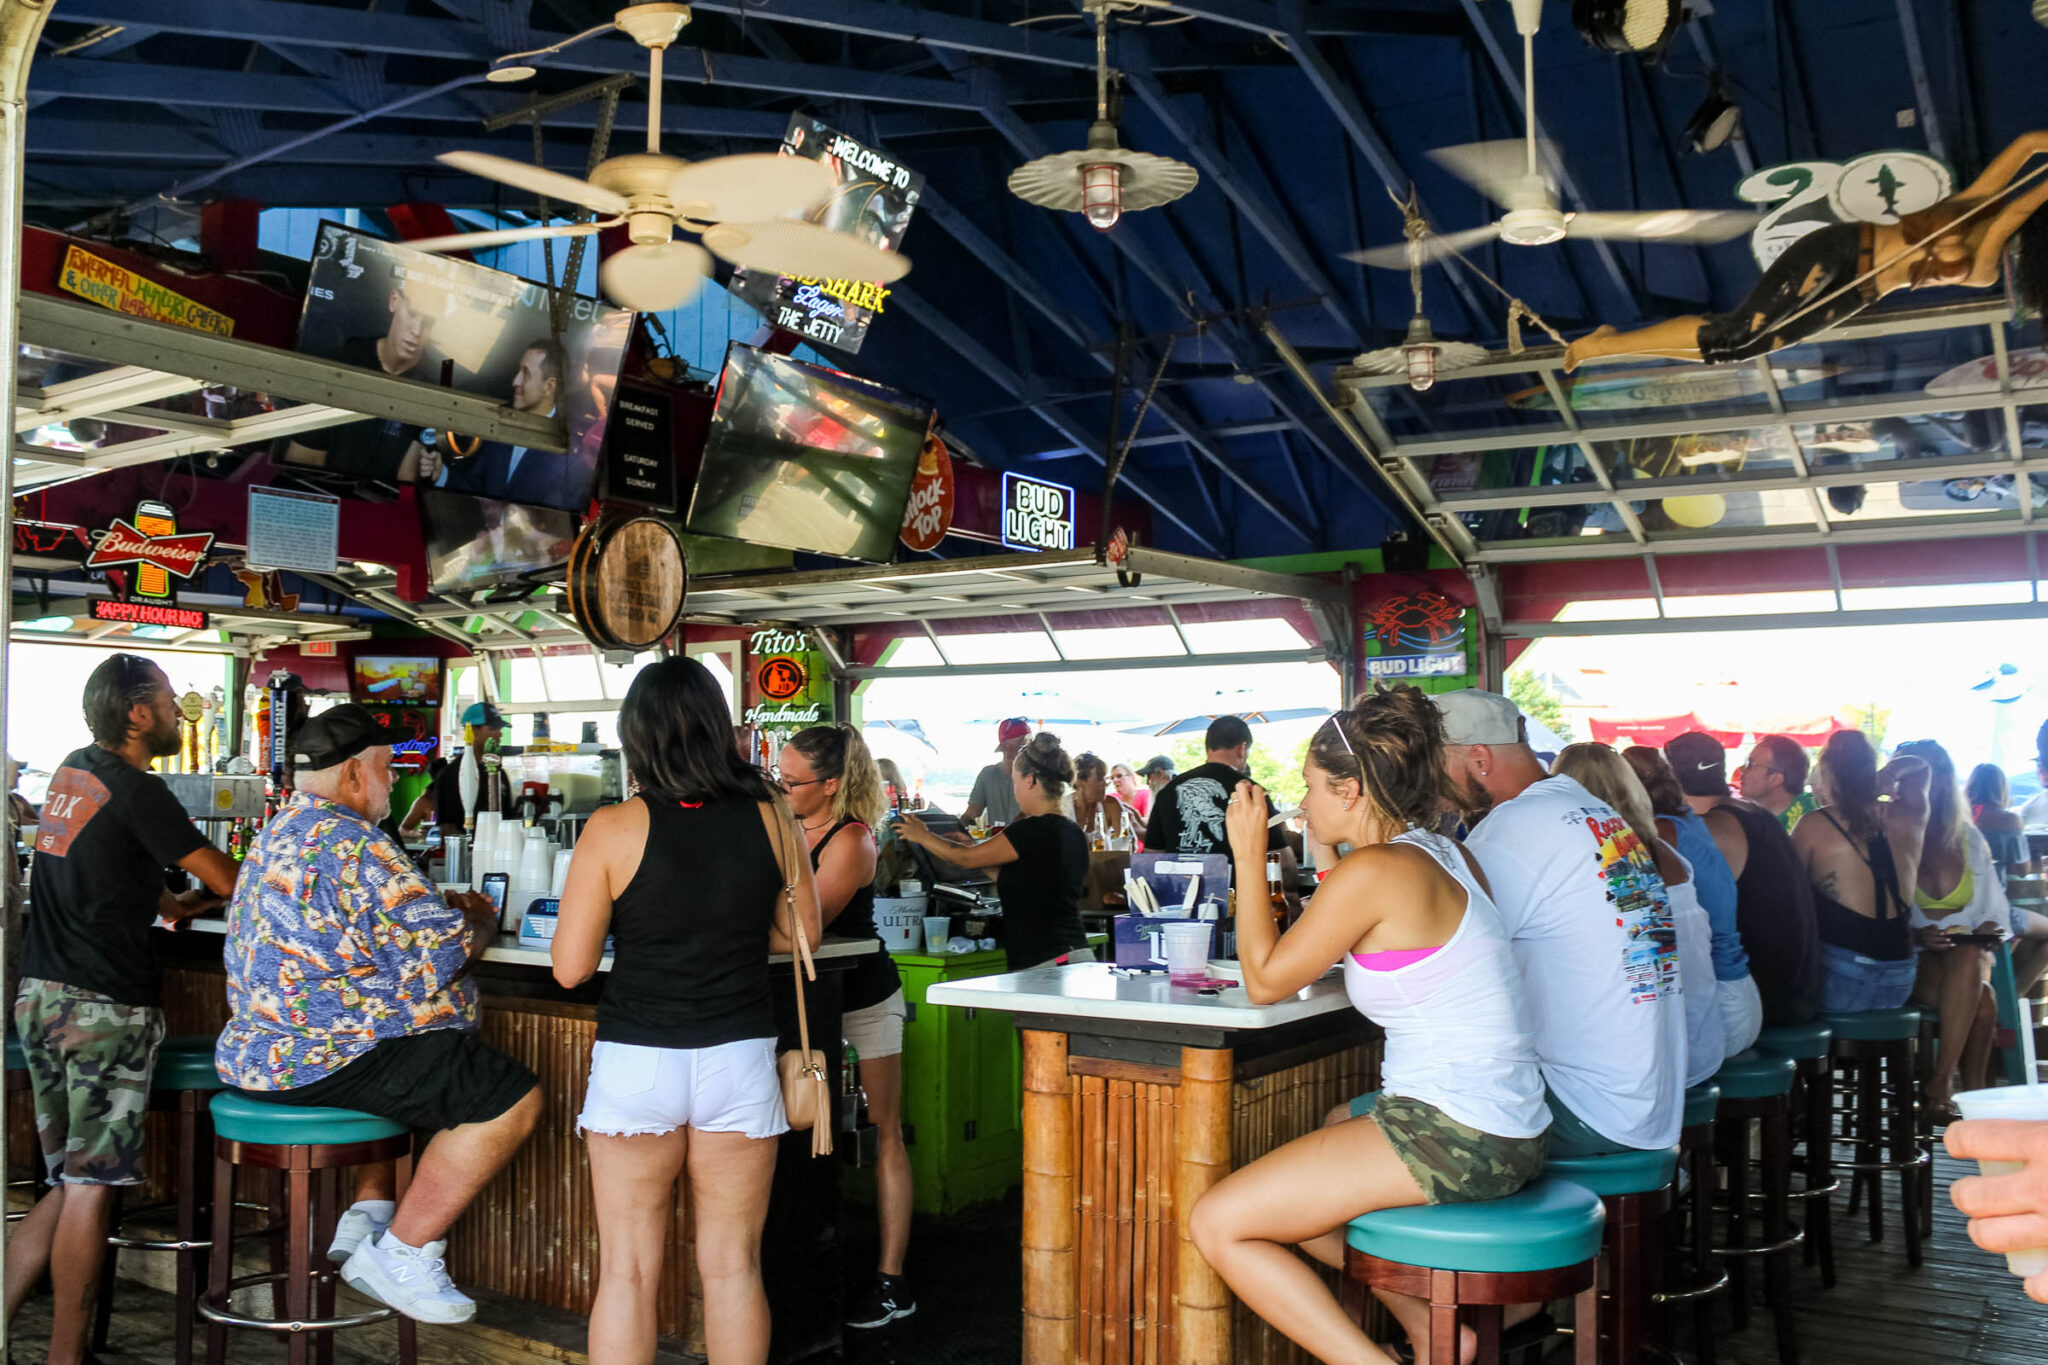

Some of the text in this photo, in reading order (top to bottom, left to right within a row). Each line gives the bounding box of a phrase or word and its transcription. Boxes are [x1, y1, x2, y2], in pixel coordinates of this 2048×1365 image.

[832, 135, 910, 189] WELCOME TO
[65, 270, 78, 290] &
[79, 278, 118, 308] OTHER
[793, 285, 845, 318] Lager
[818, 276, 892, 314] SHARK
[777, 306, 845, 344] THE JETTY
[619, 400, 659, 416] BREAKFAST
[625, 417, 655, 431] SERVED
[623, 453, 659, 468] SATURDAY
[626, 477, 656, 490] SUNDAY
[1016, 480, 1064, 519] BUD
[912, 505, 942, 542] TOP
[1006, 508, 1071, 550] LIGHT
[91, 529, 207, 562] Budweiser
[129, 595, 174, 607] DRAUGHT
[140, 605, 178, 624] HOUR
[1369, 655, 1462, 675] BUD LIGHT
[744, 702, 820, 724] Handmade
[275, 700, 286, 763] BUD LIGHT
